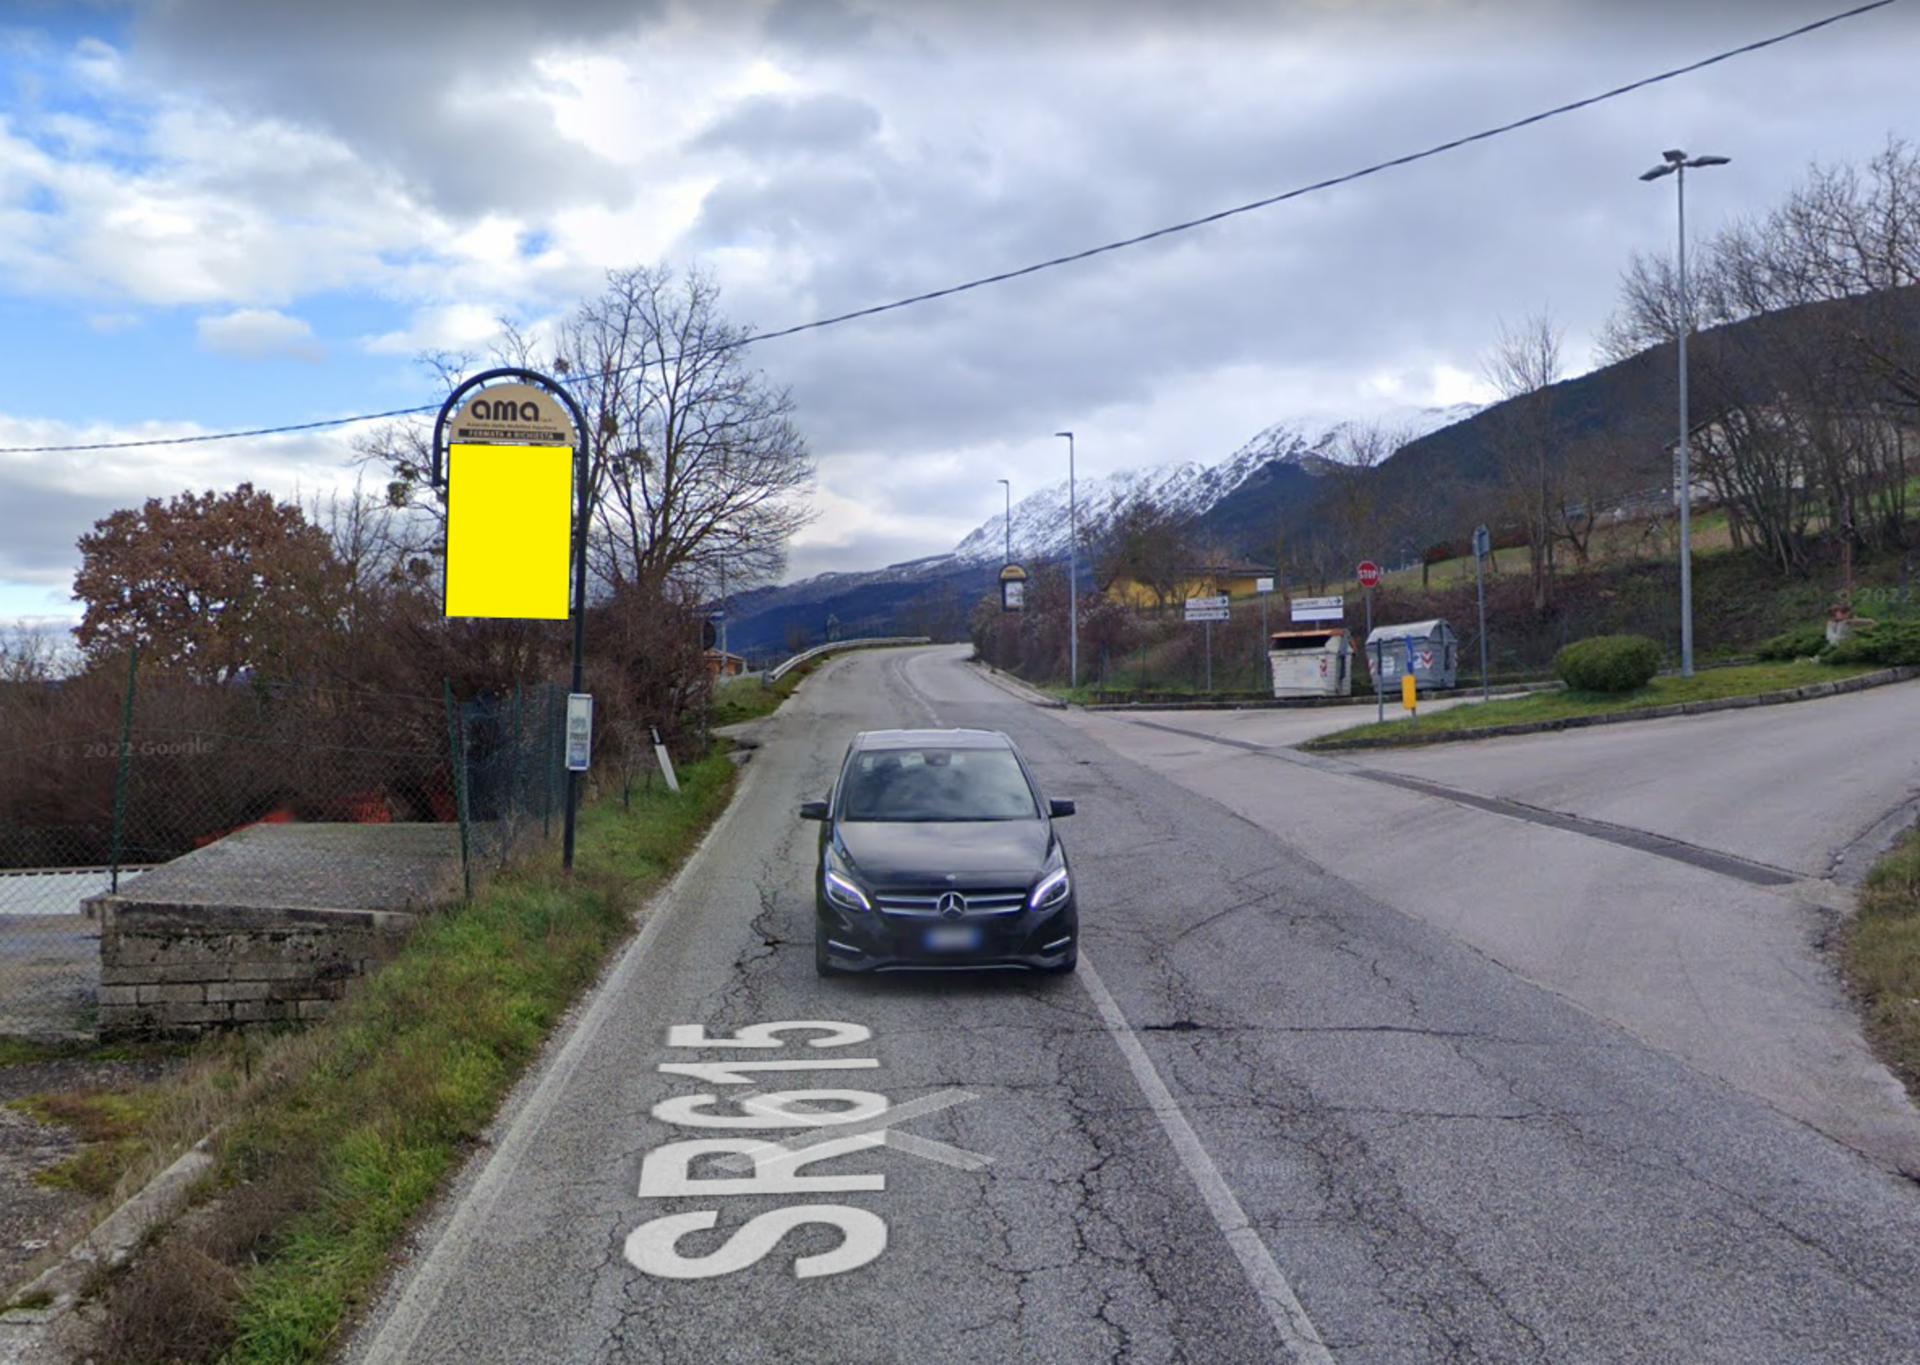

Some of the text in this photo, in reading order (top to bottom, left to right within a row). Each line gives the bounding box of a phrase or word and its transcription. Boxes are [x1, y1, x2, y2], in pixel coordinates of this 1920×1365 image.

[471, 400, 540, 421] ama
[468, 430, 505, 438] FERMATA
[513, 432, 554, 440] RICHIESTA
[1358, 569, 1376, 579] STOP
